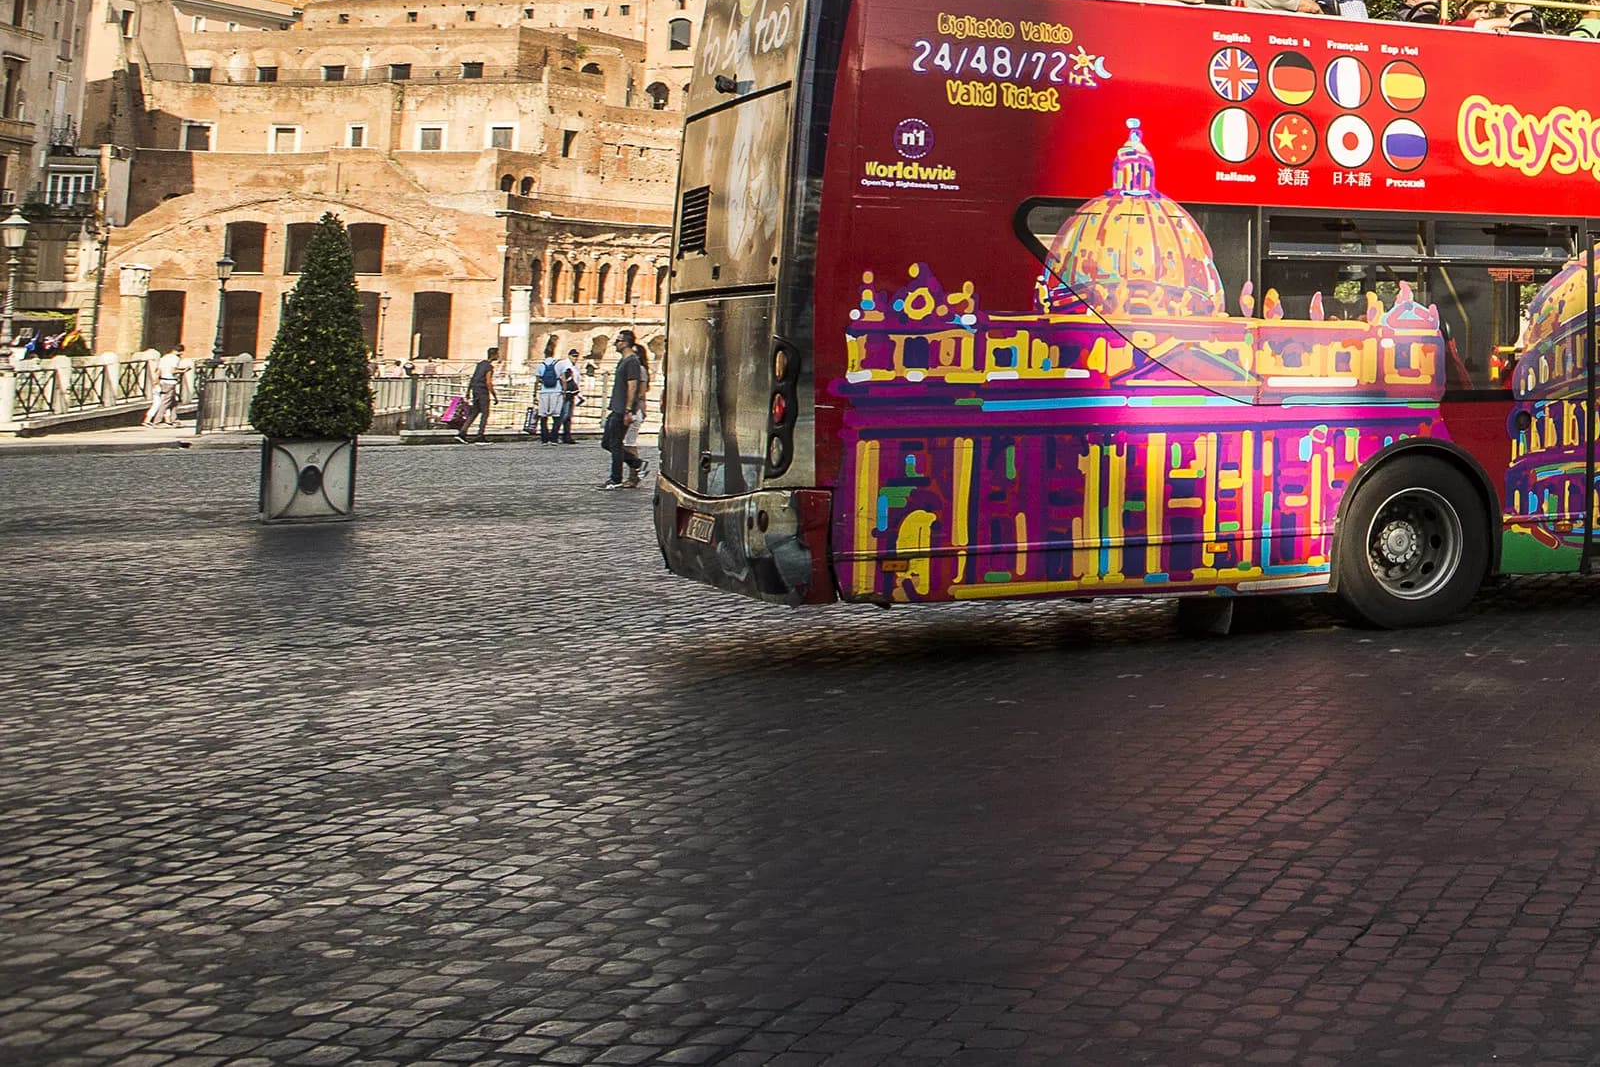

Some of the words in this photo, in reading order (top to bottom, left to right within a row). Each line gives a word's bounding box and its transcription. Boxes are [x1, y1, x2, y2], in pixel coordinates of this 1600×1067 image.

[1020, 20, 1073, 44] Valido
[1212, 31, 1251, 44] English
[701, 17, 720, 77] to
[1326, 40, 1369, 53] Français
[912, 40, 1067, 82] 24/48/72
[946, 80, 997, 106] Valid
[1000, 81, 1060, 112] Ticket
[865, 161, 957, 180] Worldwide
[1215, 171, 1257, 183] Italiano
[1277, 168, 1310, 186] 漢語
[1333, 171, 1372, 187] 日本語
[939, 182, 960, 191] Tours
